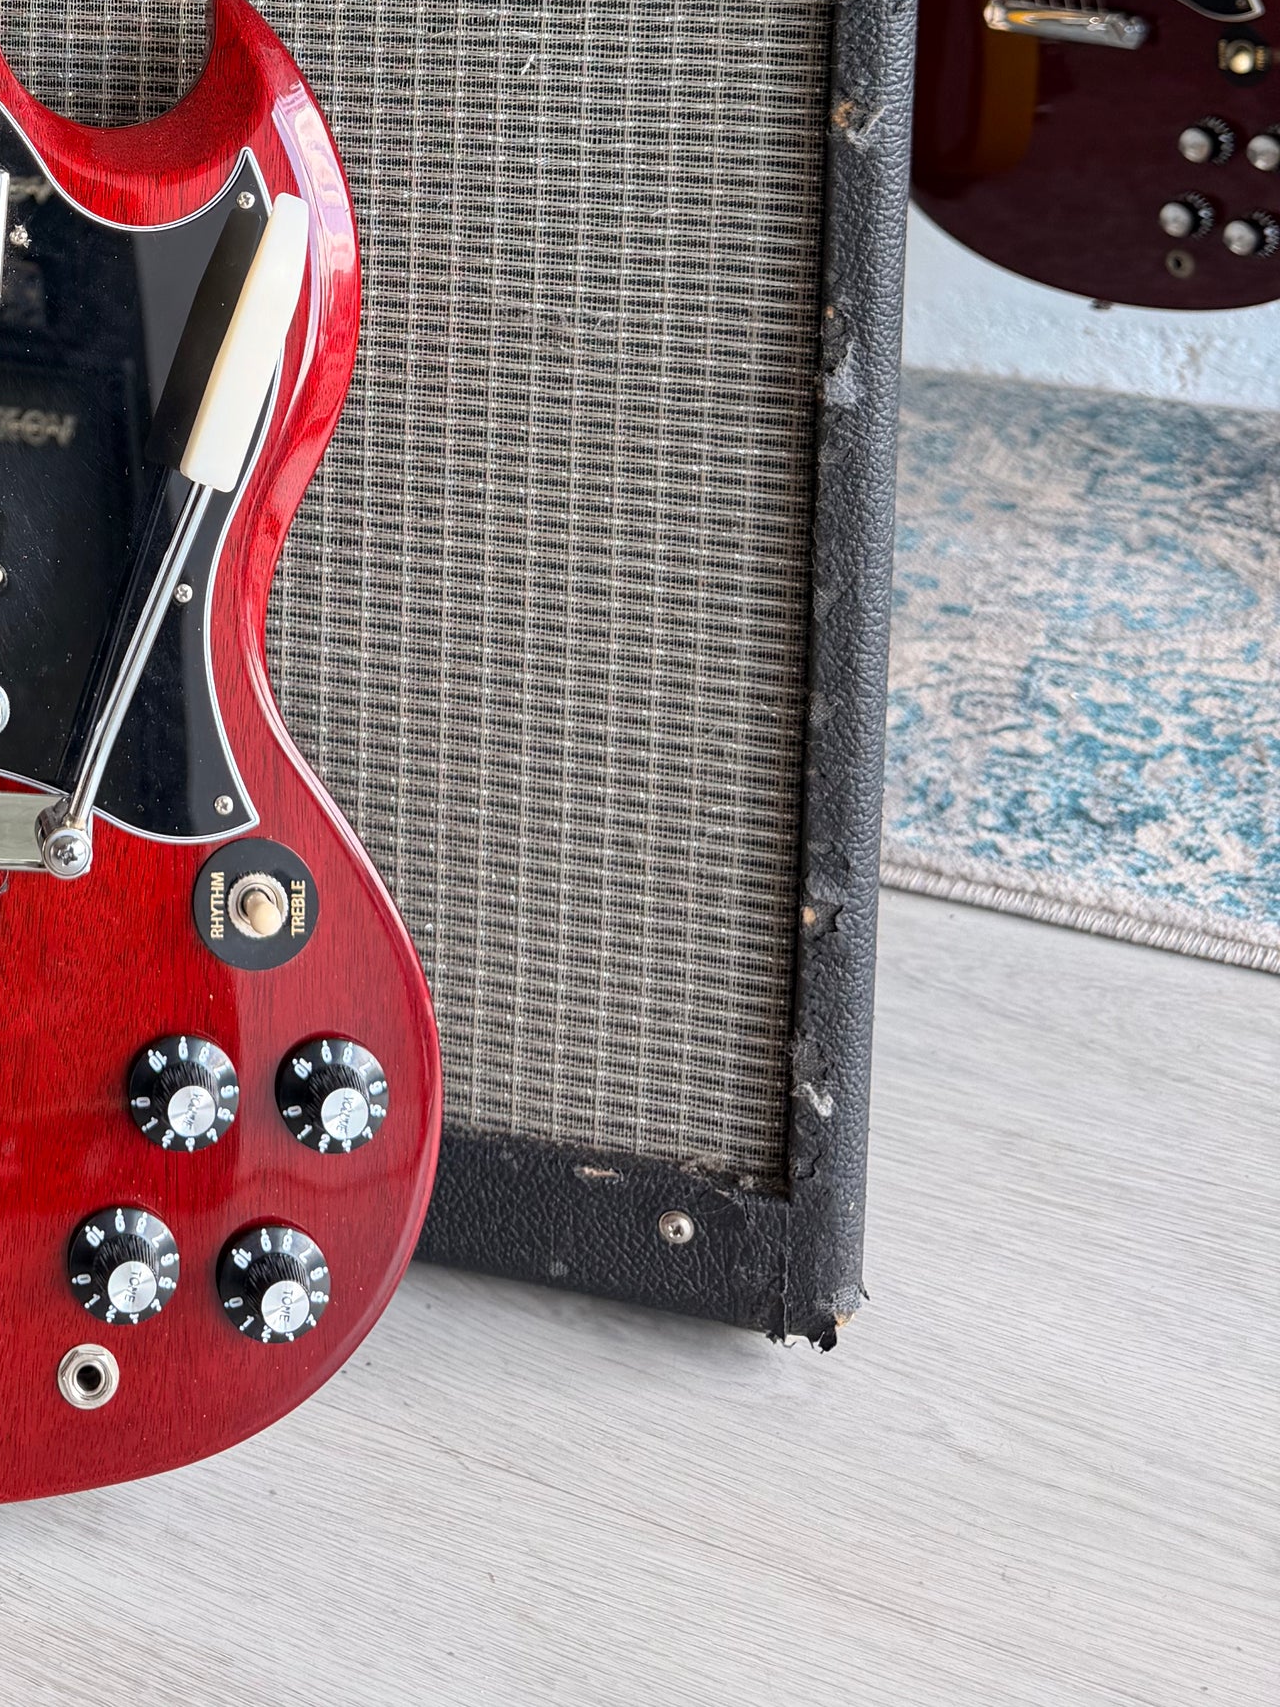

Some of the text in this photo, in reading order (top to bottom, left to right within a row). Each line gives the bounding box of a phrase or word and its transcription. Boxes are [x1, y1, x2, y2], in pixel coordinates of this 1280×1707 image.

[210, 871, 225, 939] RHYTHM
[291, 880, 306, 937] TREBLE
[280, 1290, 293, 1322] TONE
